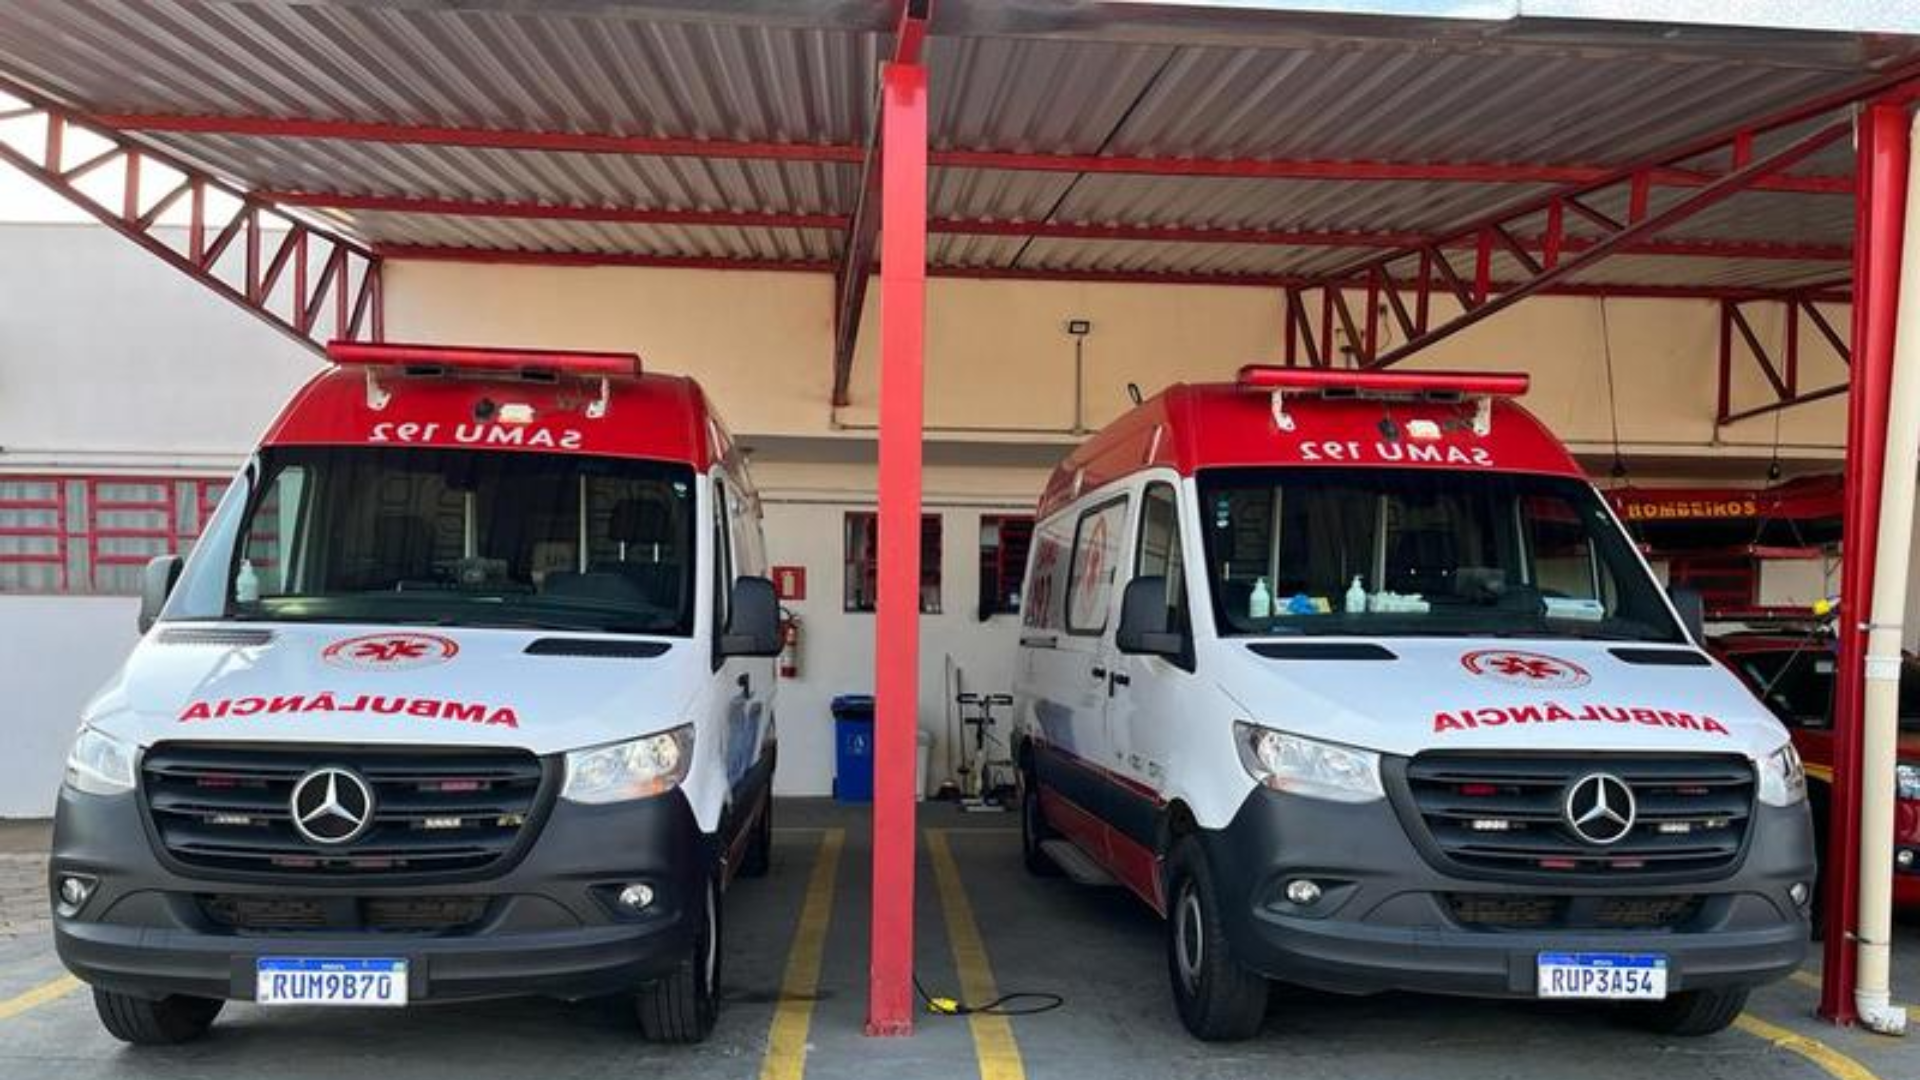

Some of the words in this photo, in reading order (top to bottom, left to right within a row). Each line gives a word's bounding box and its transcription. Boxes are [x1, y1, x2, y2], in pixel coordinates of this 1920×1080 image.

[1628, 501, 1758, 519] BOMBEIROS
[272, 973, 392, 999] RUM9B70
[1551, 968, 1653, 993] RUP3A54
